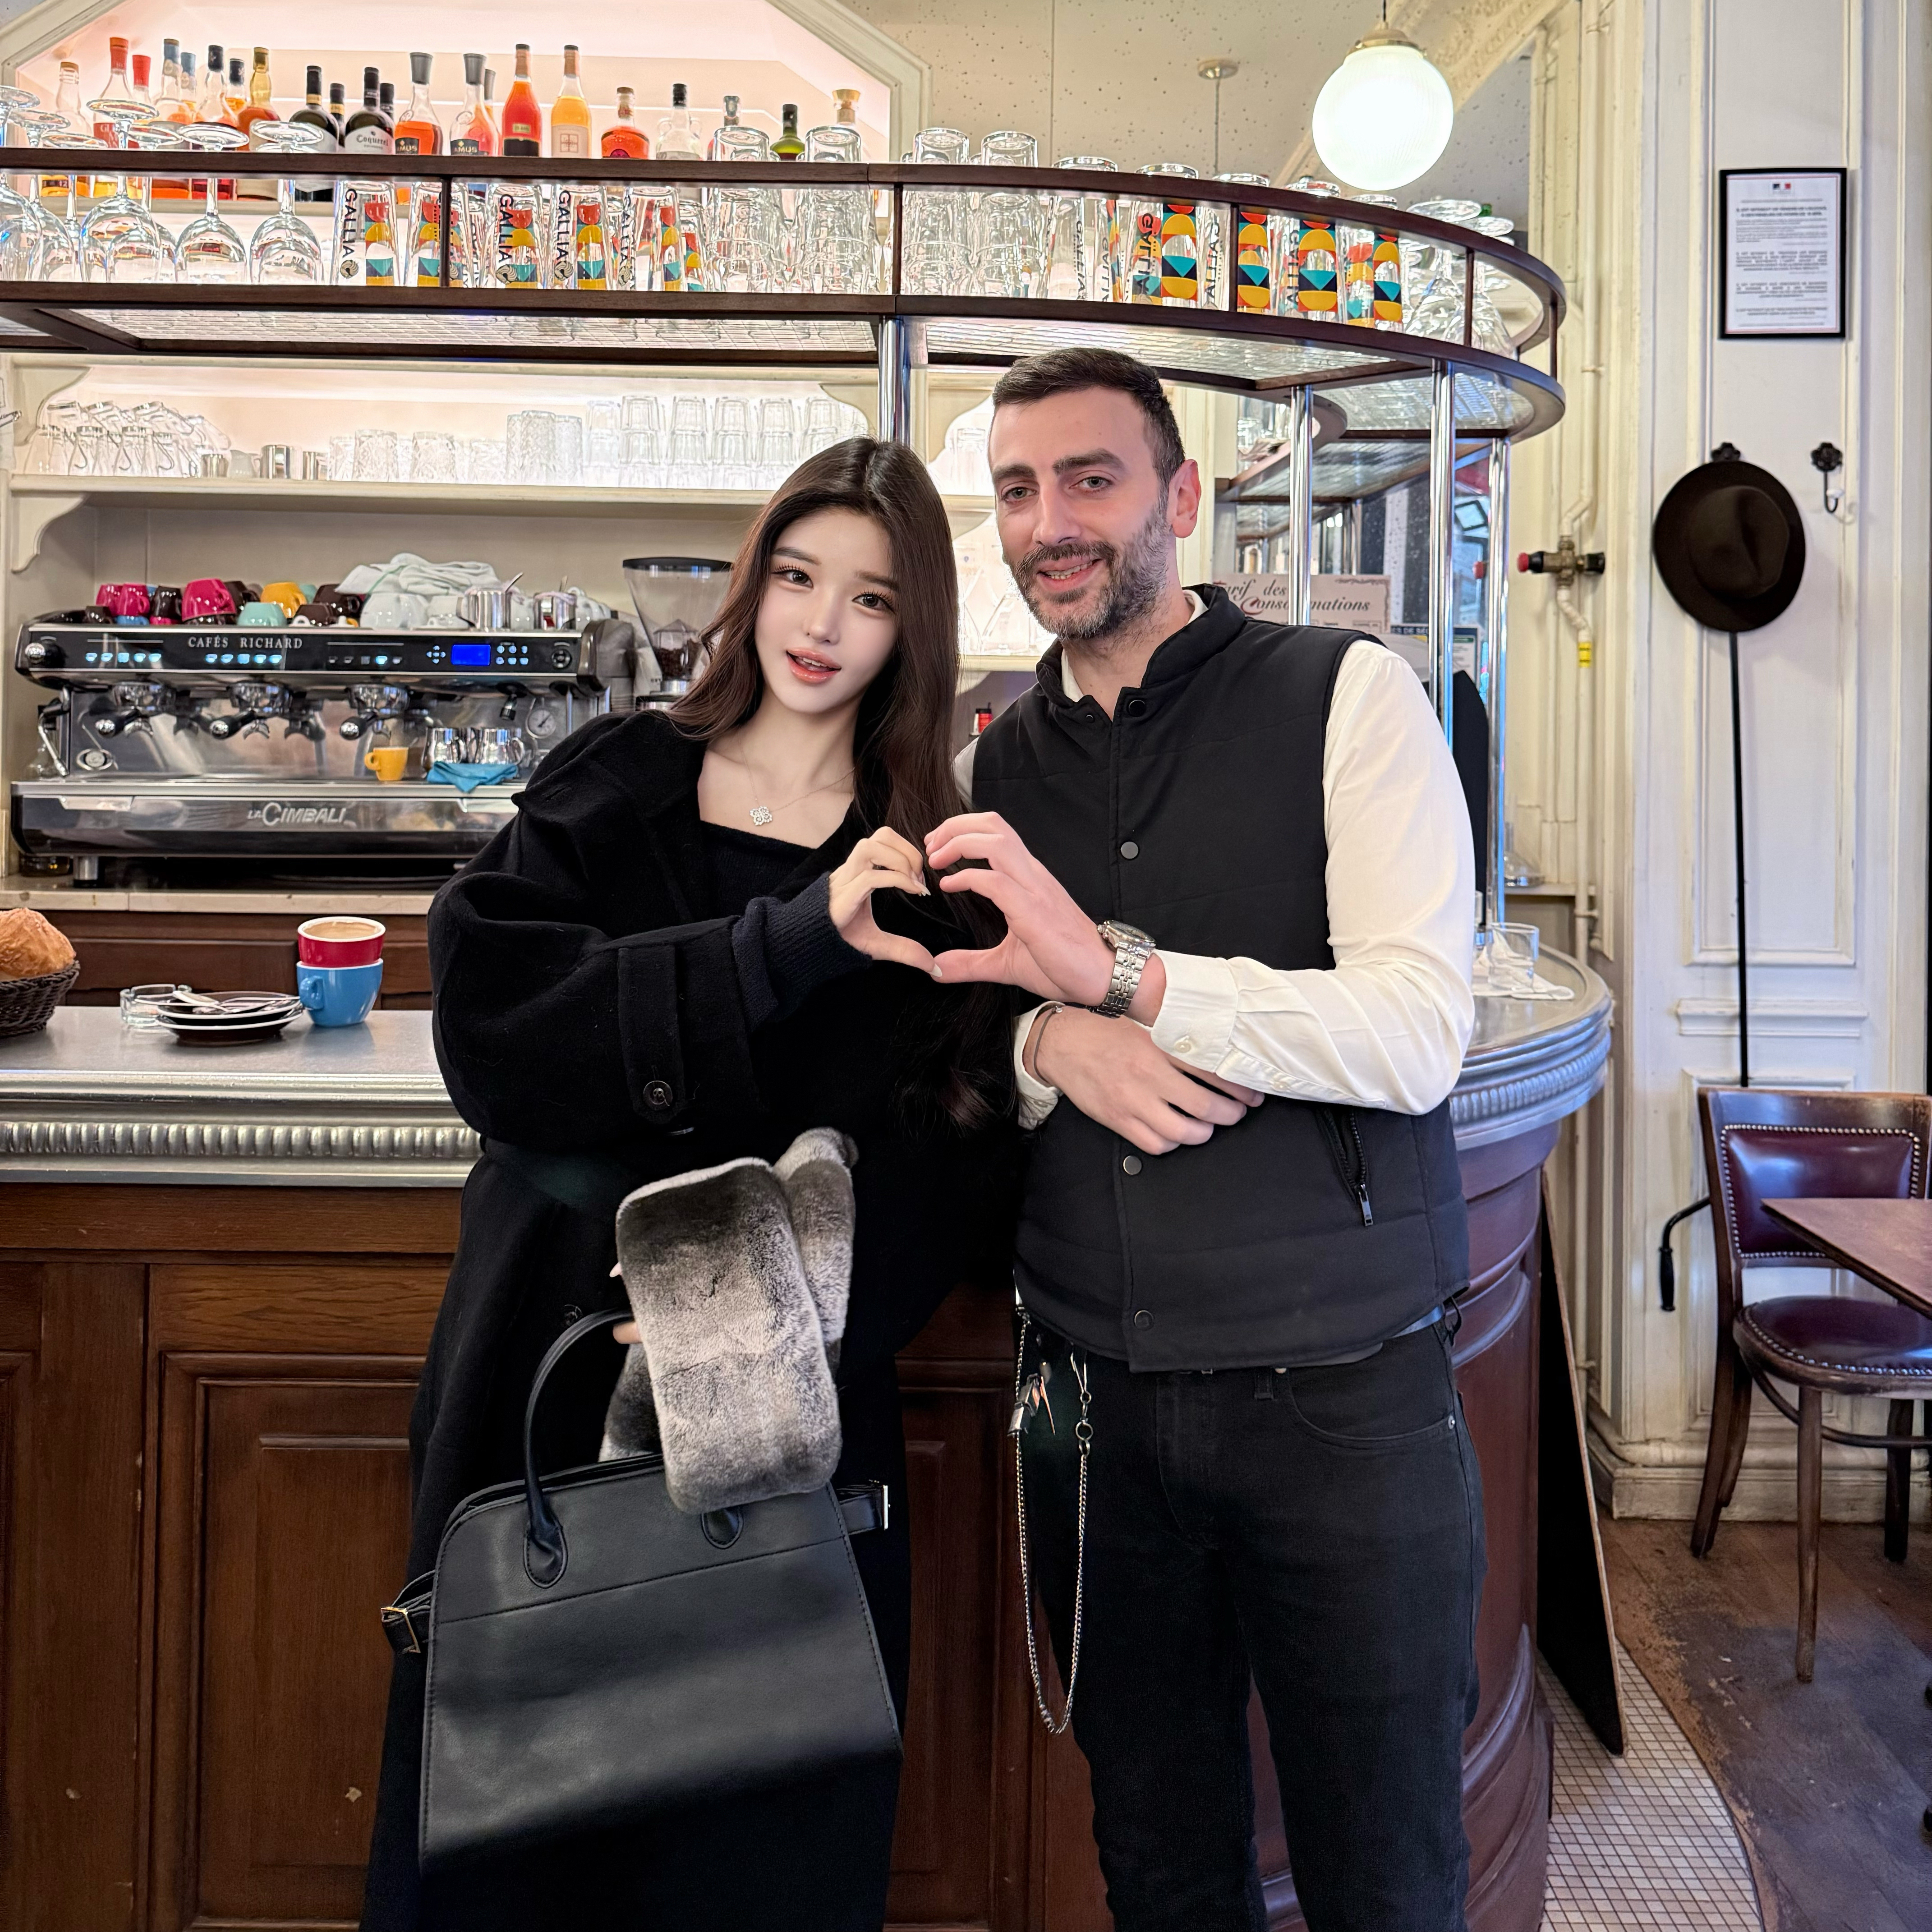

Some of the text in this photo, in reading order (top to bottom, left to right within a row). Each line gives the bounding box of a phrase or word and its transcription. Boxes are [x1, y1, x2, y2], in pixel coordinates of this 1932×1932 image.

[342, 189, 358, 258] GALLIA
[499, 194, 514, 262] GALLIA
[556, 190, 571, 260] GALLIA
[1213, 579, 1287, 601] rif des
[1240, 596, 1370, 615] Consomations
[240, 637, 303, 649] RICHARD
[262, 802, 346, 826] CIMBALI
